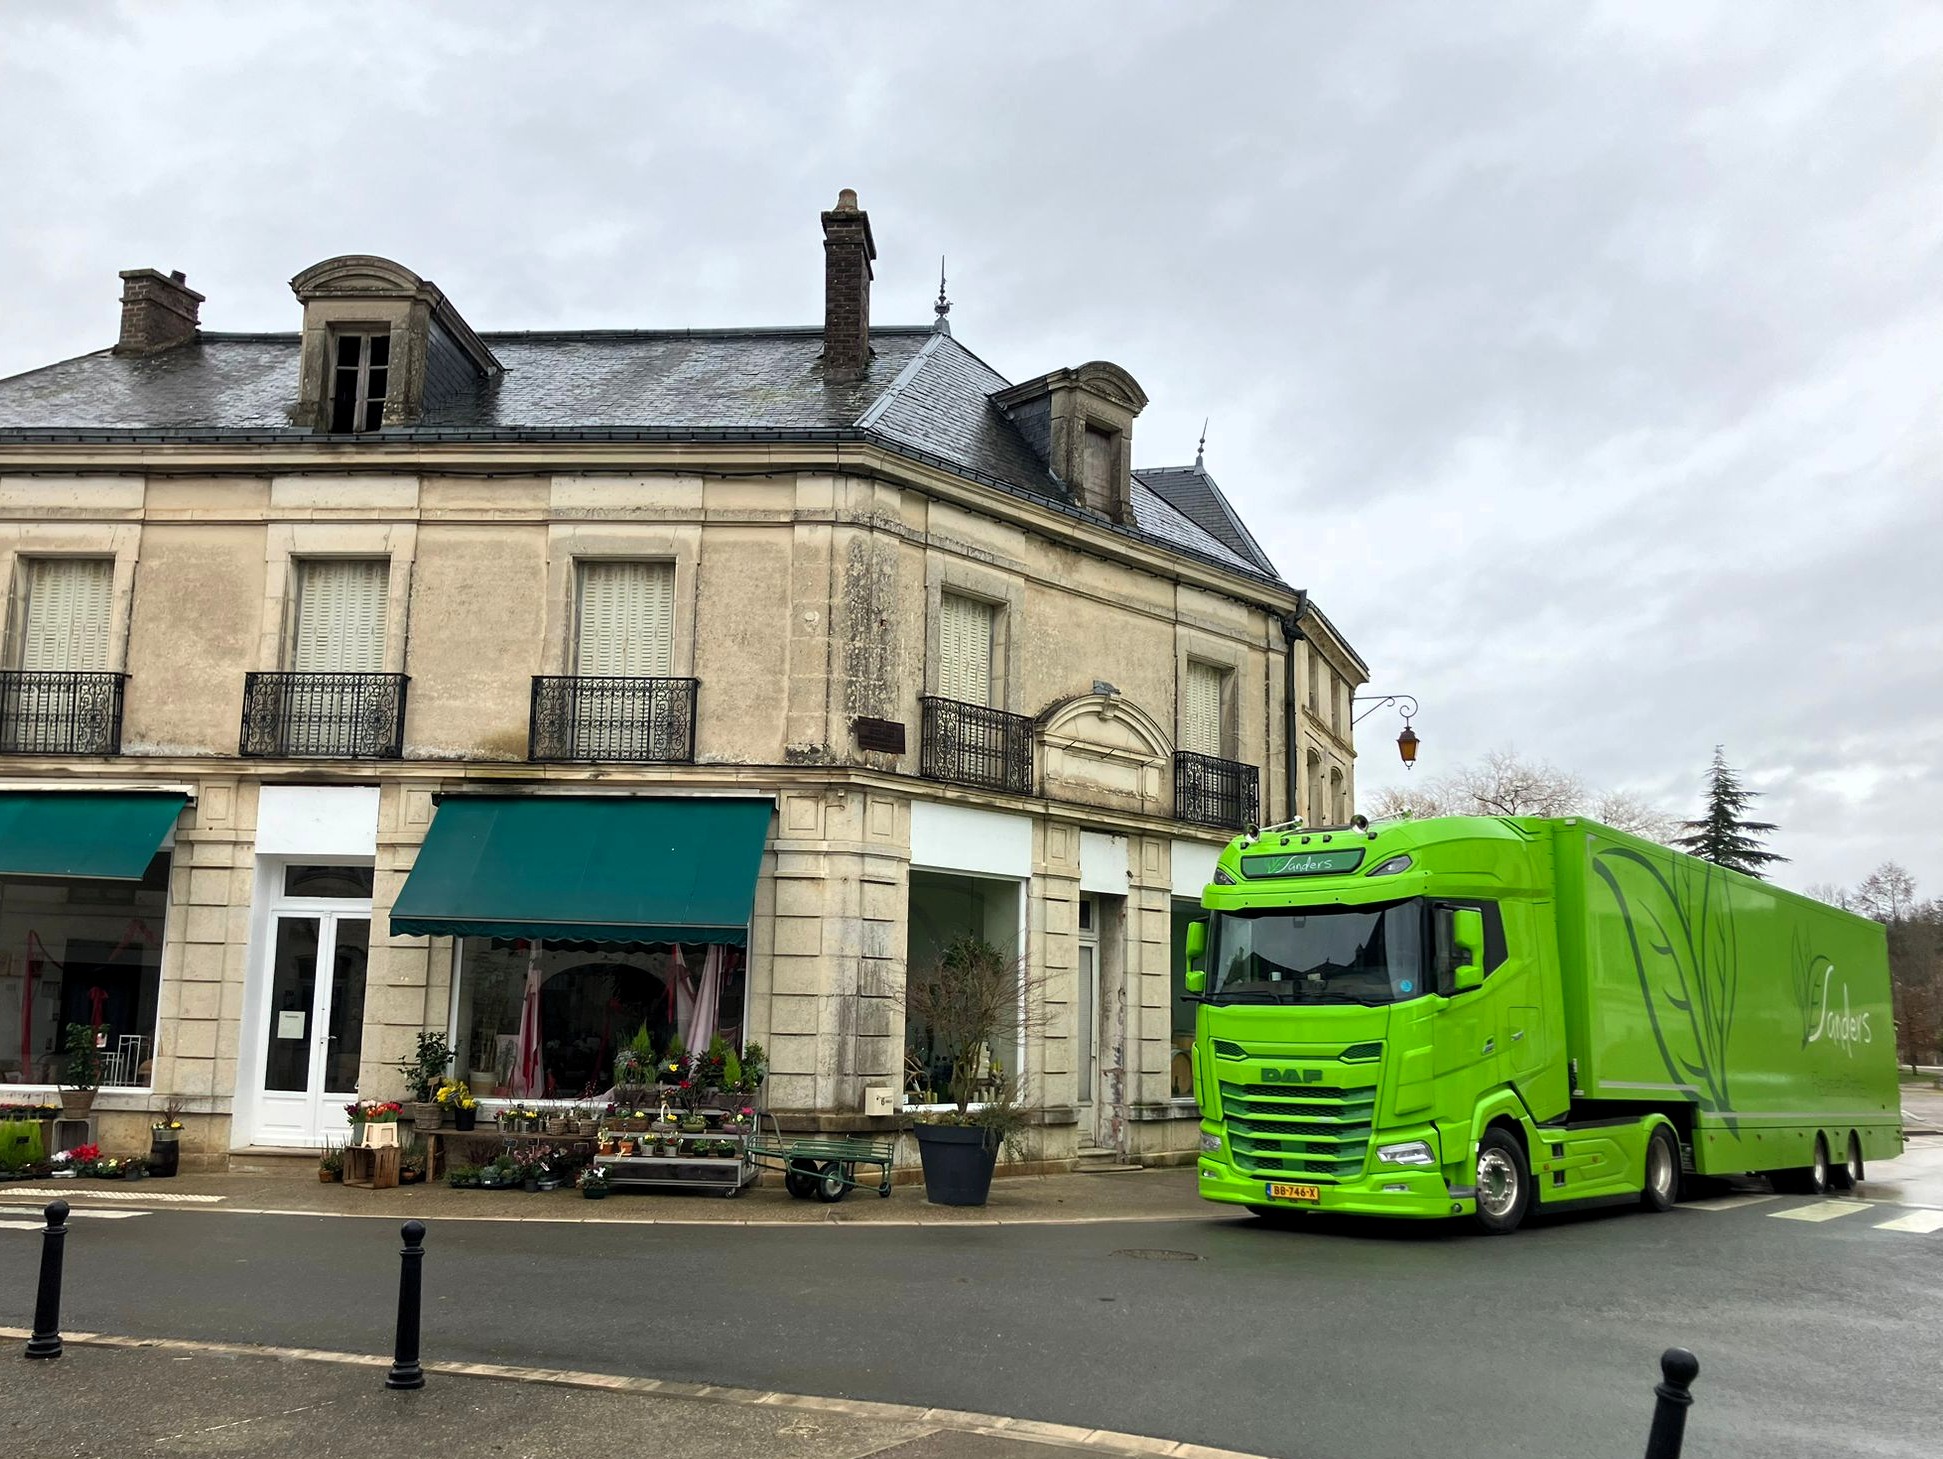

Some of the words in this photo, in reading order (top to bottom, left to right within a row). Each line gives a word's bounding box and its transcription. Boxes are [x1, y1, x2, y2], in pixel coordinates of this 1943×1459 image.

[1275, 855, 1332, 873] Sanders
[1808, 965, 1872, 1059] Sanders
[1261, 1067, 1323, 1083] DAF
[1273, 1185, 1316, 1198] BB-746-X
